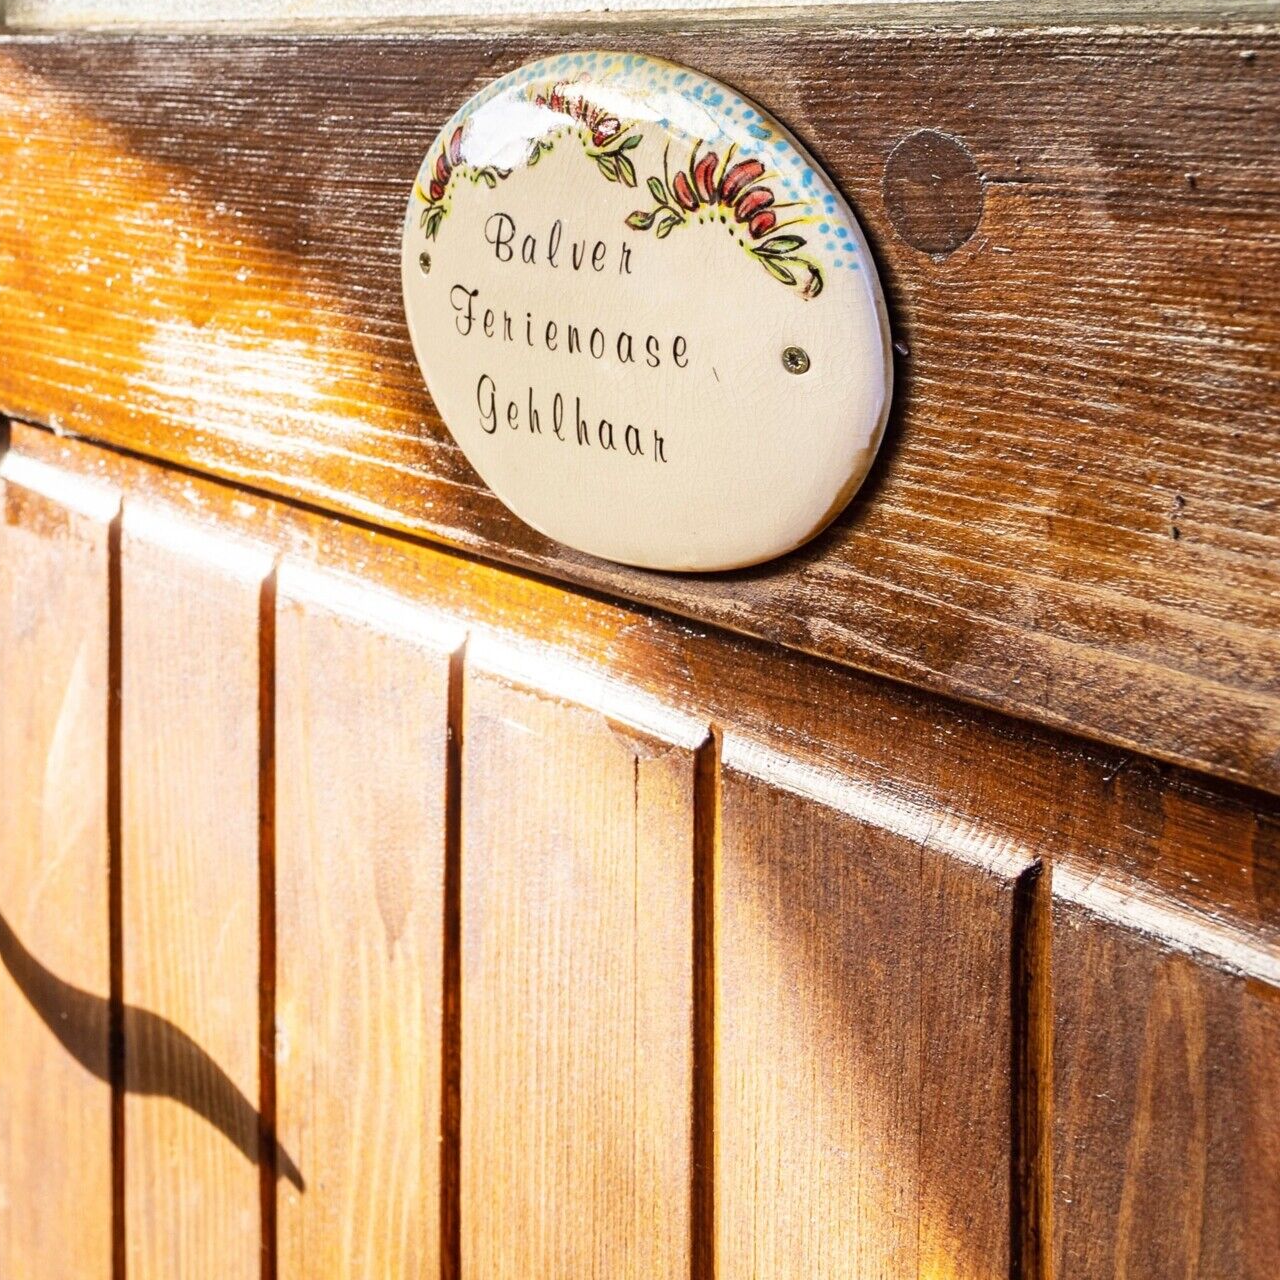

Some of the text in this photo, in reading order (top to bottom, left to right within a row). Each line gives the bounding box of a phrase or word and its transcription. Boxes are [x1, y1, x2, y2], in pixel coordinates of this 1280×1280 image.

[484, 211, 633, 275] Balver
[448, 283, 690, 369] Ferienoase
[476, 373, 668, 464] Gehlhaar
